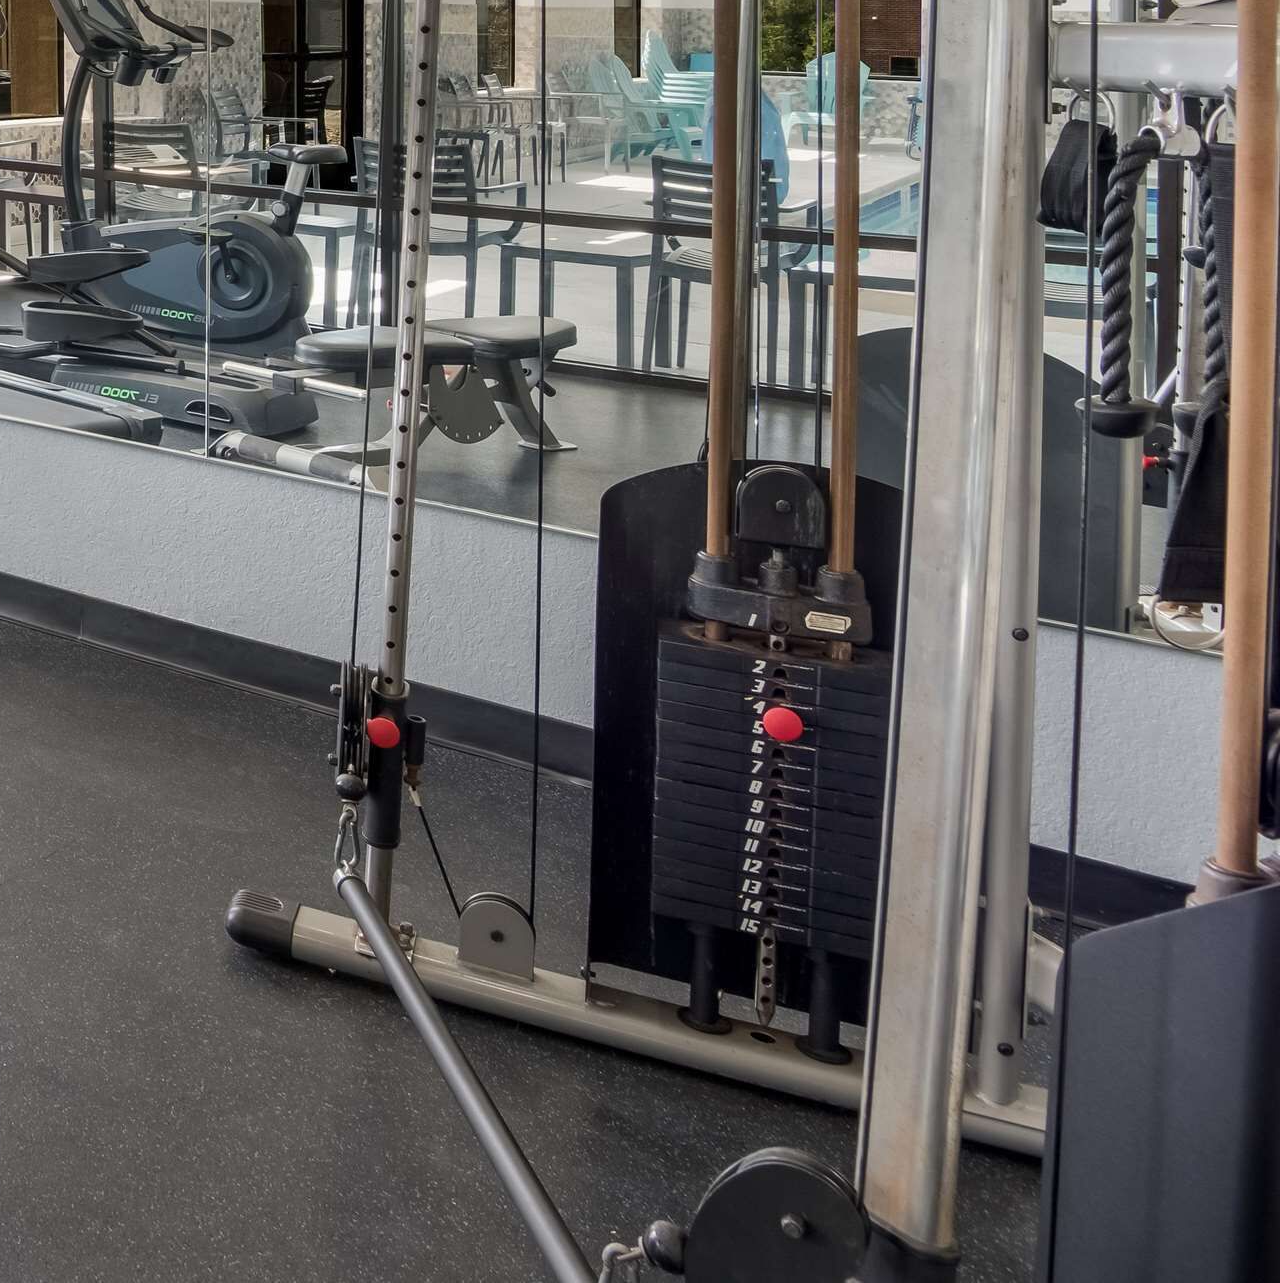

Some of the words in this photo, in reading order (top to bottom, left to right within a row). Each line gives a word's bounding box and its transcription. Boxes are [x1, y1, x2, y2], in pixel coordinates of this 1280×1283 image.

[752, 659, 767, 674] 2
[751, 678, 766, 693] 3
[752, 700, 766, 714] 4
[752, 720, 765, 735] 5
[751, 740, 765, 754] 6
[751, 760, 764, 774] 7
[749, 779, 763, 794] 8
[750, 799, 764, 814] 9
[744, 818, 765, 834] 10
[744, 838, 760, 853] 11
[742, 858, 763, 874] 12
[742, 879, 762, 894] 13
[742, 898, 763, 914] 14
[740, 917, 761, 934] 15
